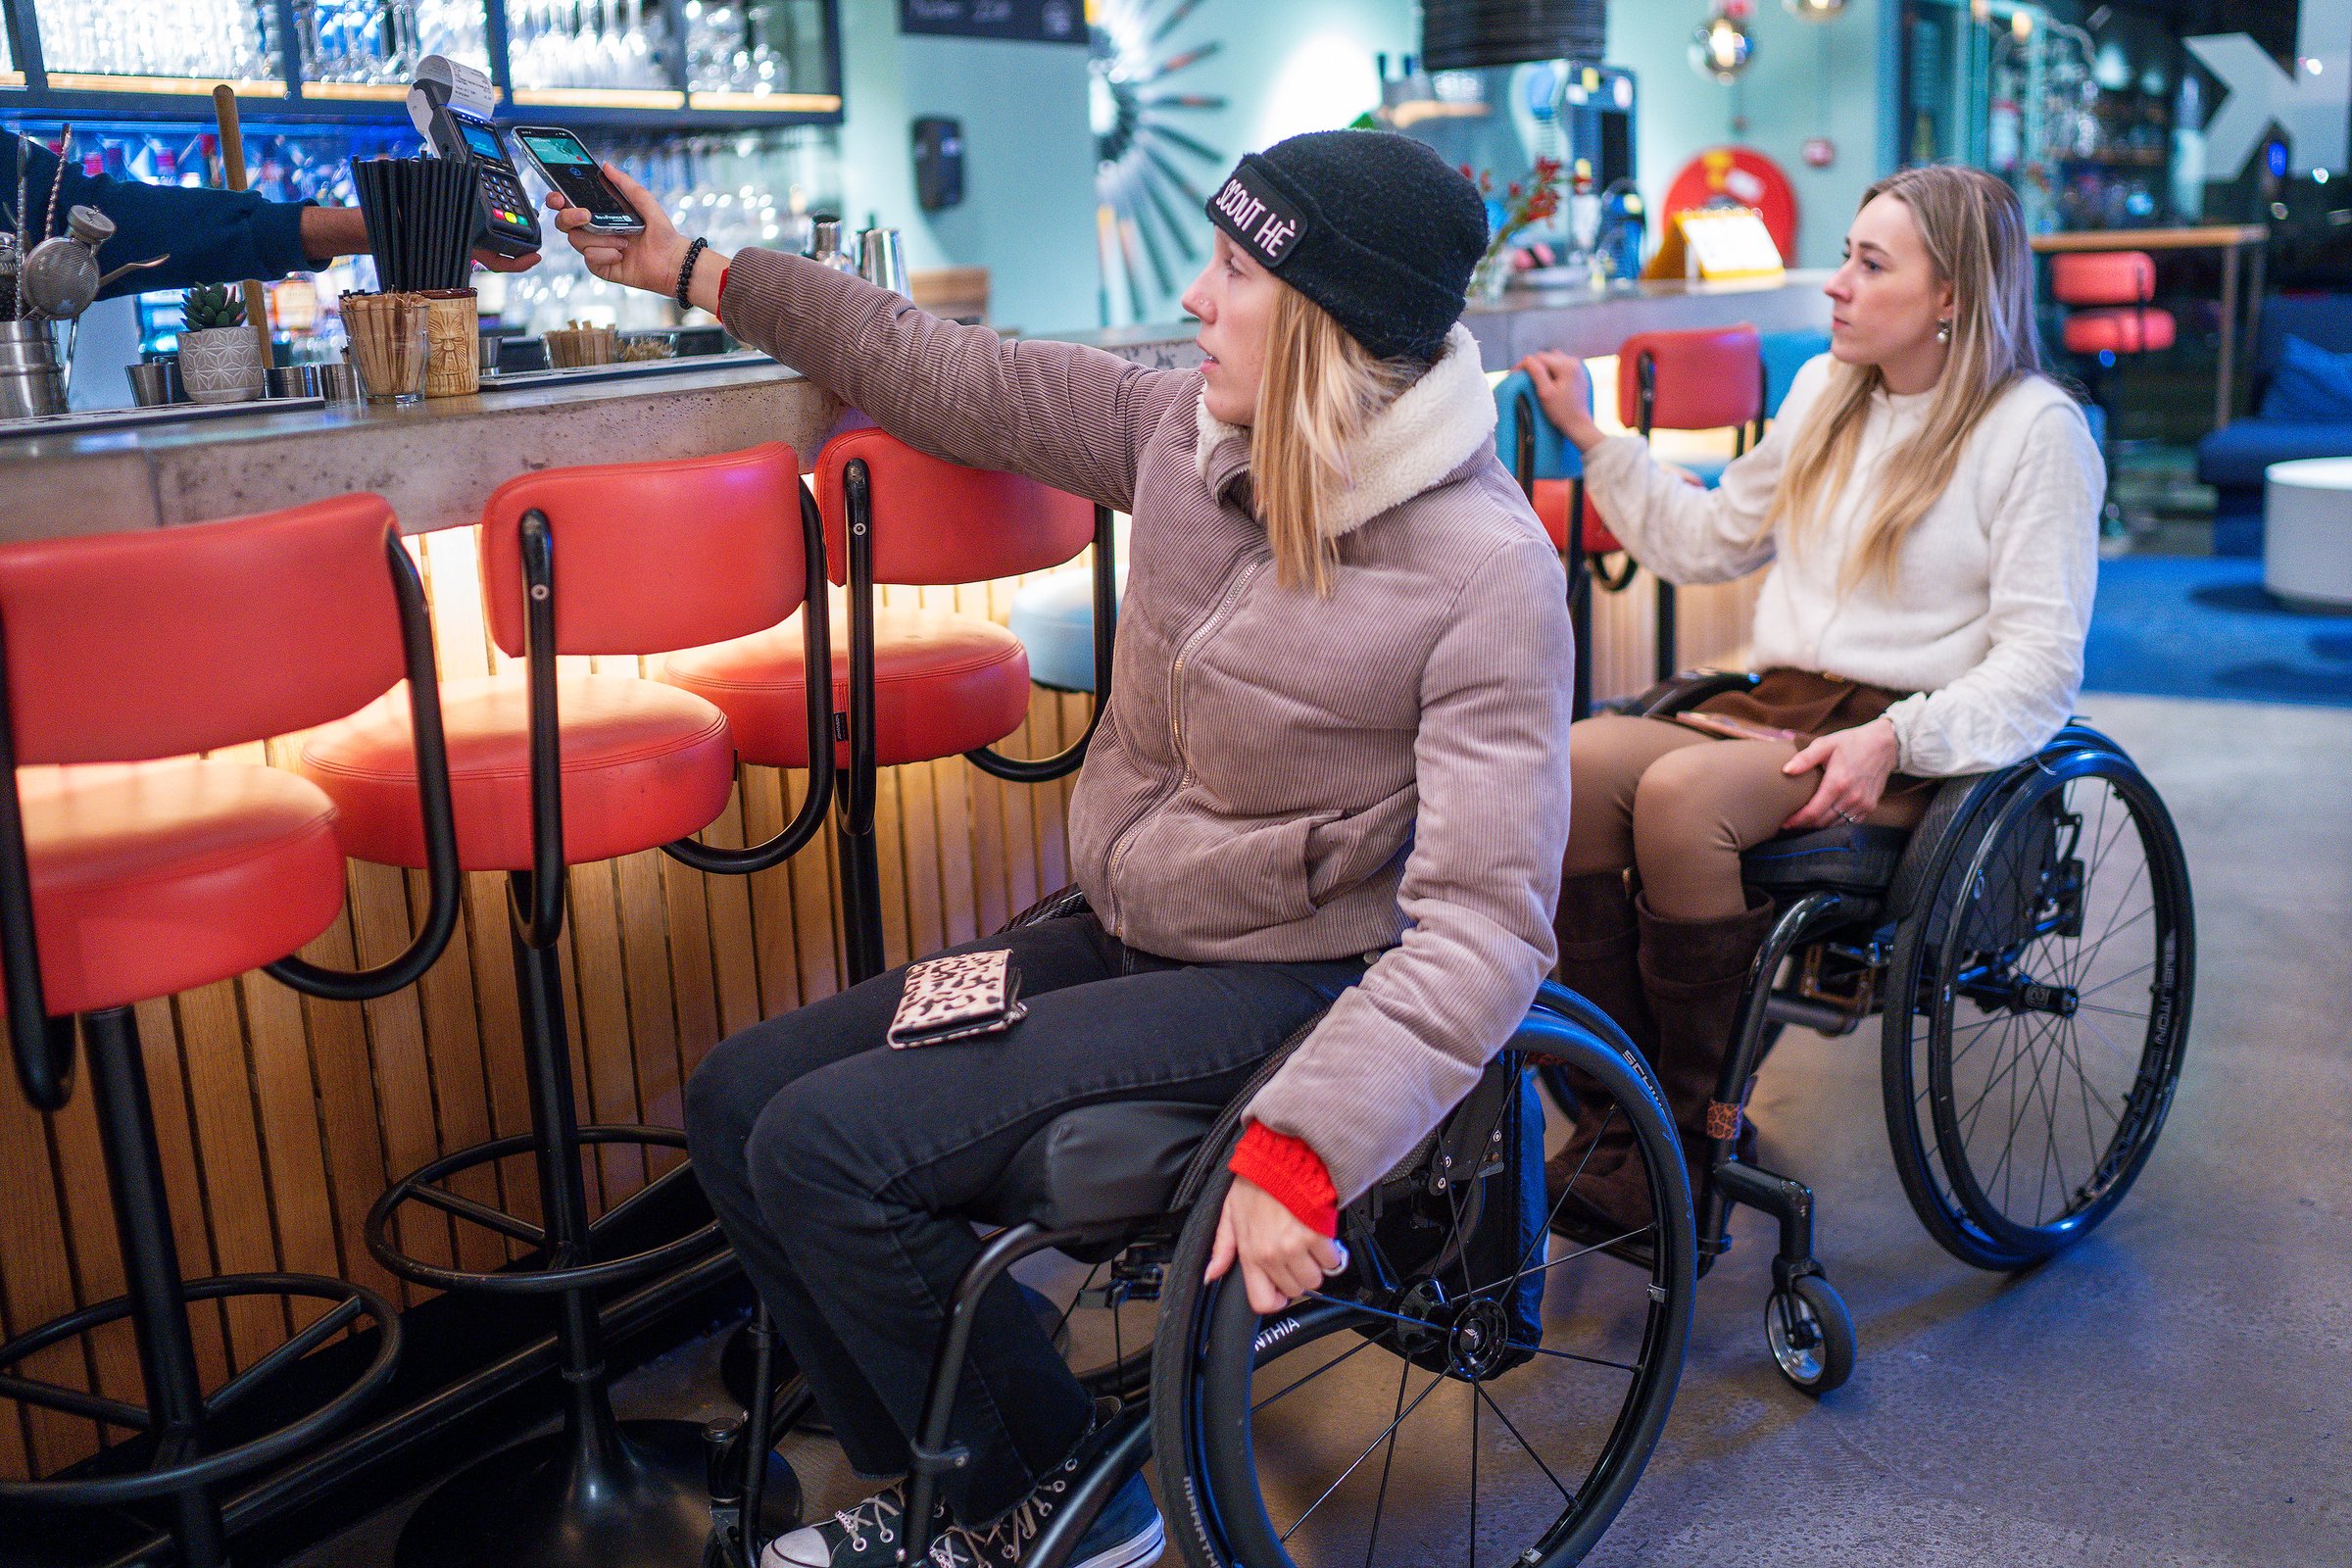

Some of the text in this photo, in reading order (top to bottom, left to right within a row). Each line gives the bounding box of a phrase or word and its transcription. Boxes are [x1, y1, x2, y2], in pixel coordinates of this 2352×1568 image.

[1216, 179, 1296, 257] SCOUT HÈ
[1183, 1475, 1224, 1568] MARATH
